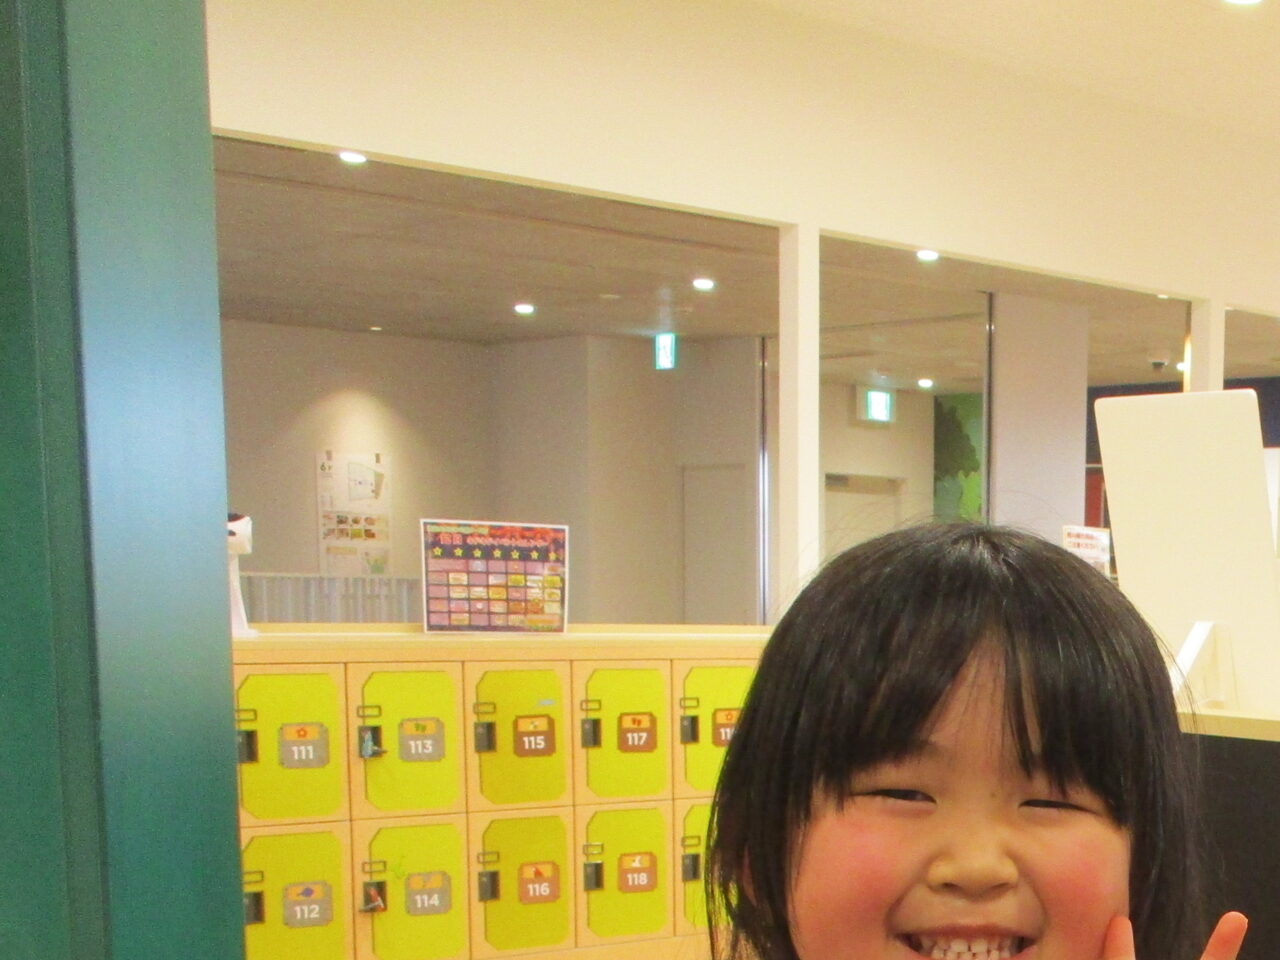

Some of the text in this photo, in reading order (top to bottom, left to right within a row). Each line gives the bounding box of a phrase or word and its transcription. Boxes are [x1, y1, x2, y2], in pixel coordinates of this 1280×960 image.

[627, 733, 648, 746] 117
[720, 727, 735, 741] 11
[408, 740, 433, 754] 113
[523, 736, 545, 749] 115
[291, 745, 314, 760] 111
[627, 873, 648, 885] 118
[527, 883, 550, 896] 116
[415, 894, 440, 908] 114
[294, 905, 320, 919] 112
